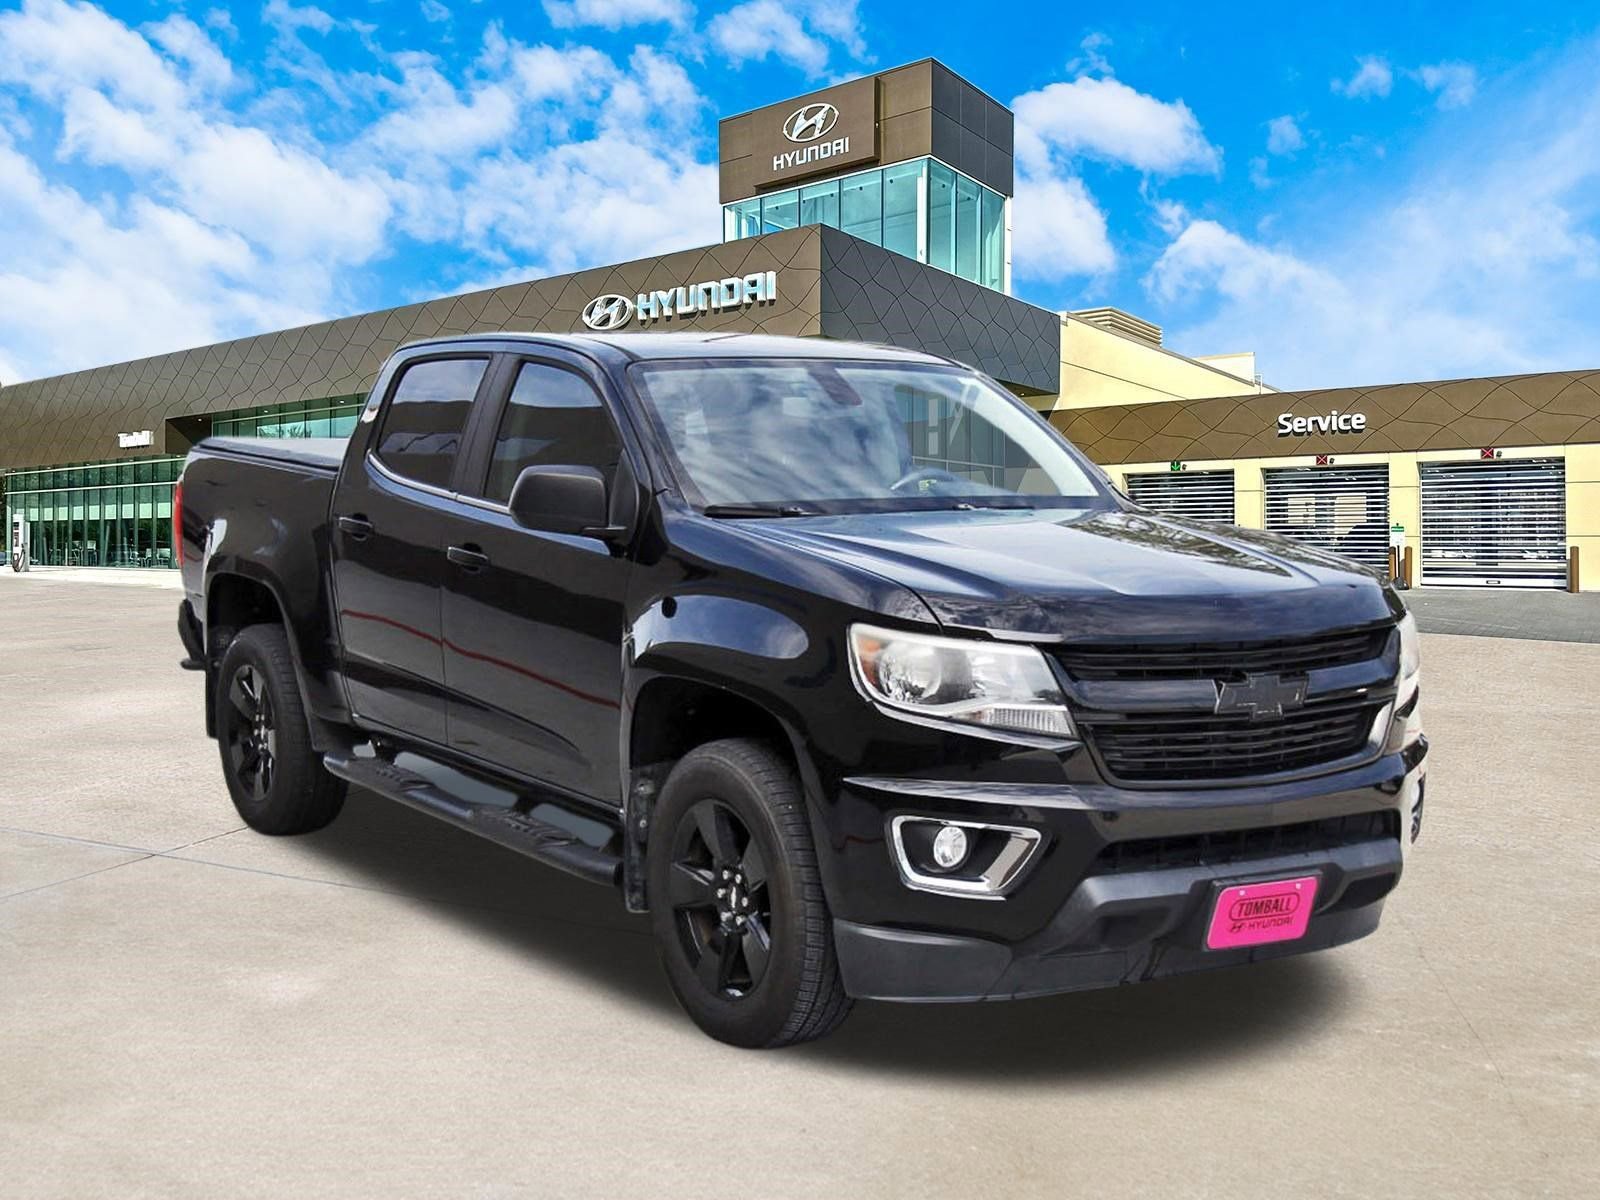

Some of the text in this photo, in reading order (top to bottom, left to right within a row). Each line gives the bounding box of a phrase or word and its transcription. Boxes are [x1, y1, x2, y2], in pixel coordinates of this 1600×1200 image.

[773, 136, 849, 171] HYUNDAI
[637, 271, 776, 321] HYUNDAI
[1278, 410, 1366, 434] Service
[1238, 897, 1292, 917] TOMBALL
[1248, 916, 1294, 930] HYUNDAI
